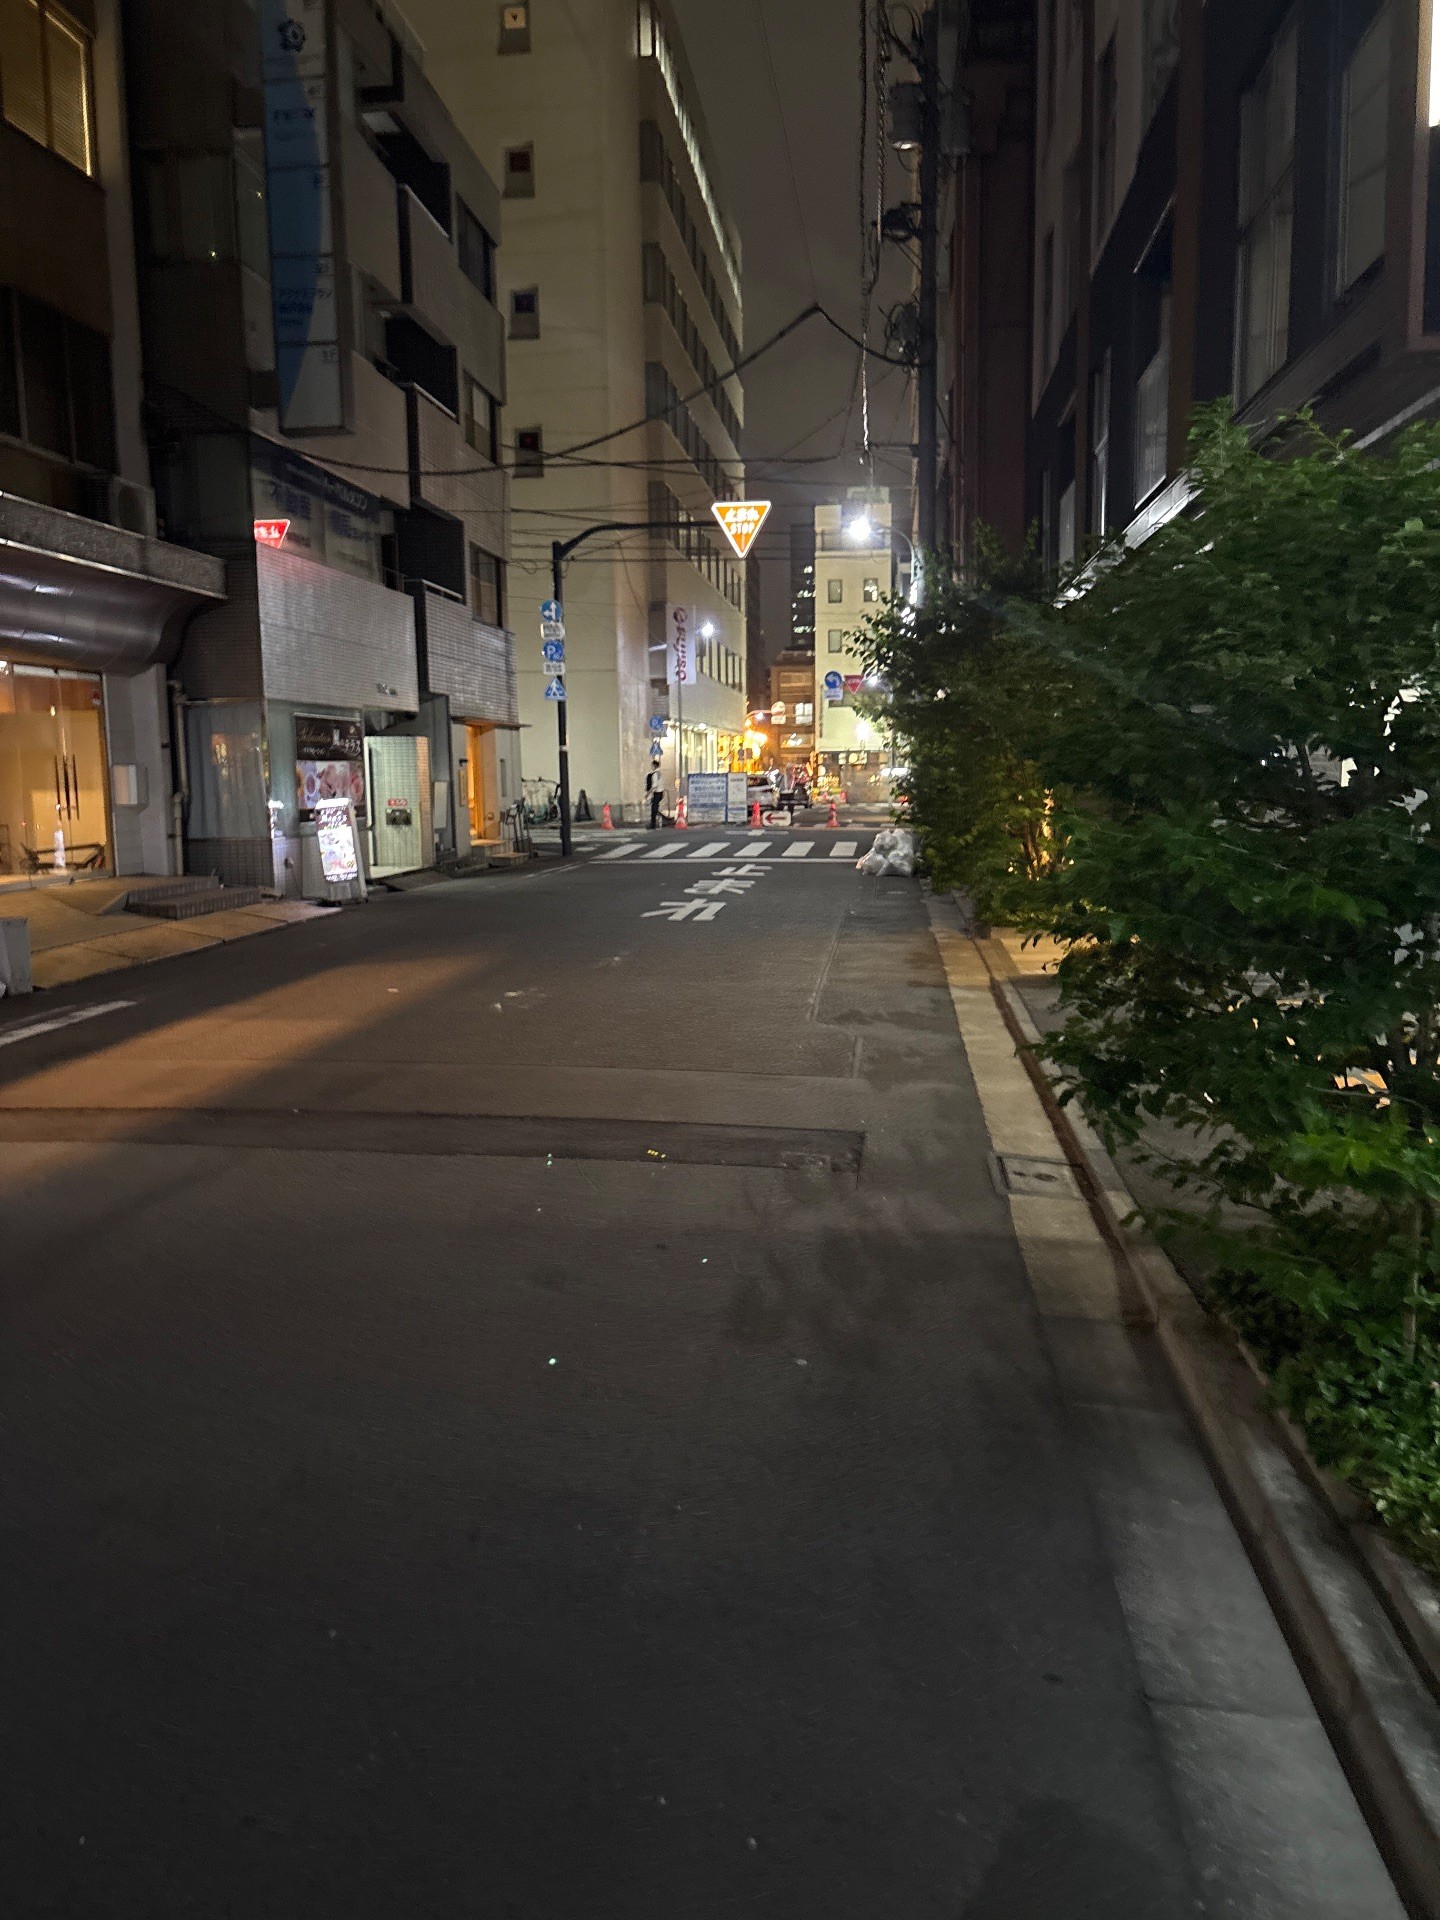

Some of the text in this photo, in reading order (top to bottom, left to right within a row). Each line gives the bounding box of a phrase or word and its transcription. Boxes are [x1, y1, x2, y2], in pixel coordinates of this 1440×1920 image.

[730, 522, 756, 535] STOP
[640, 863, 772, 921] 止まれ
